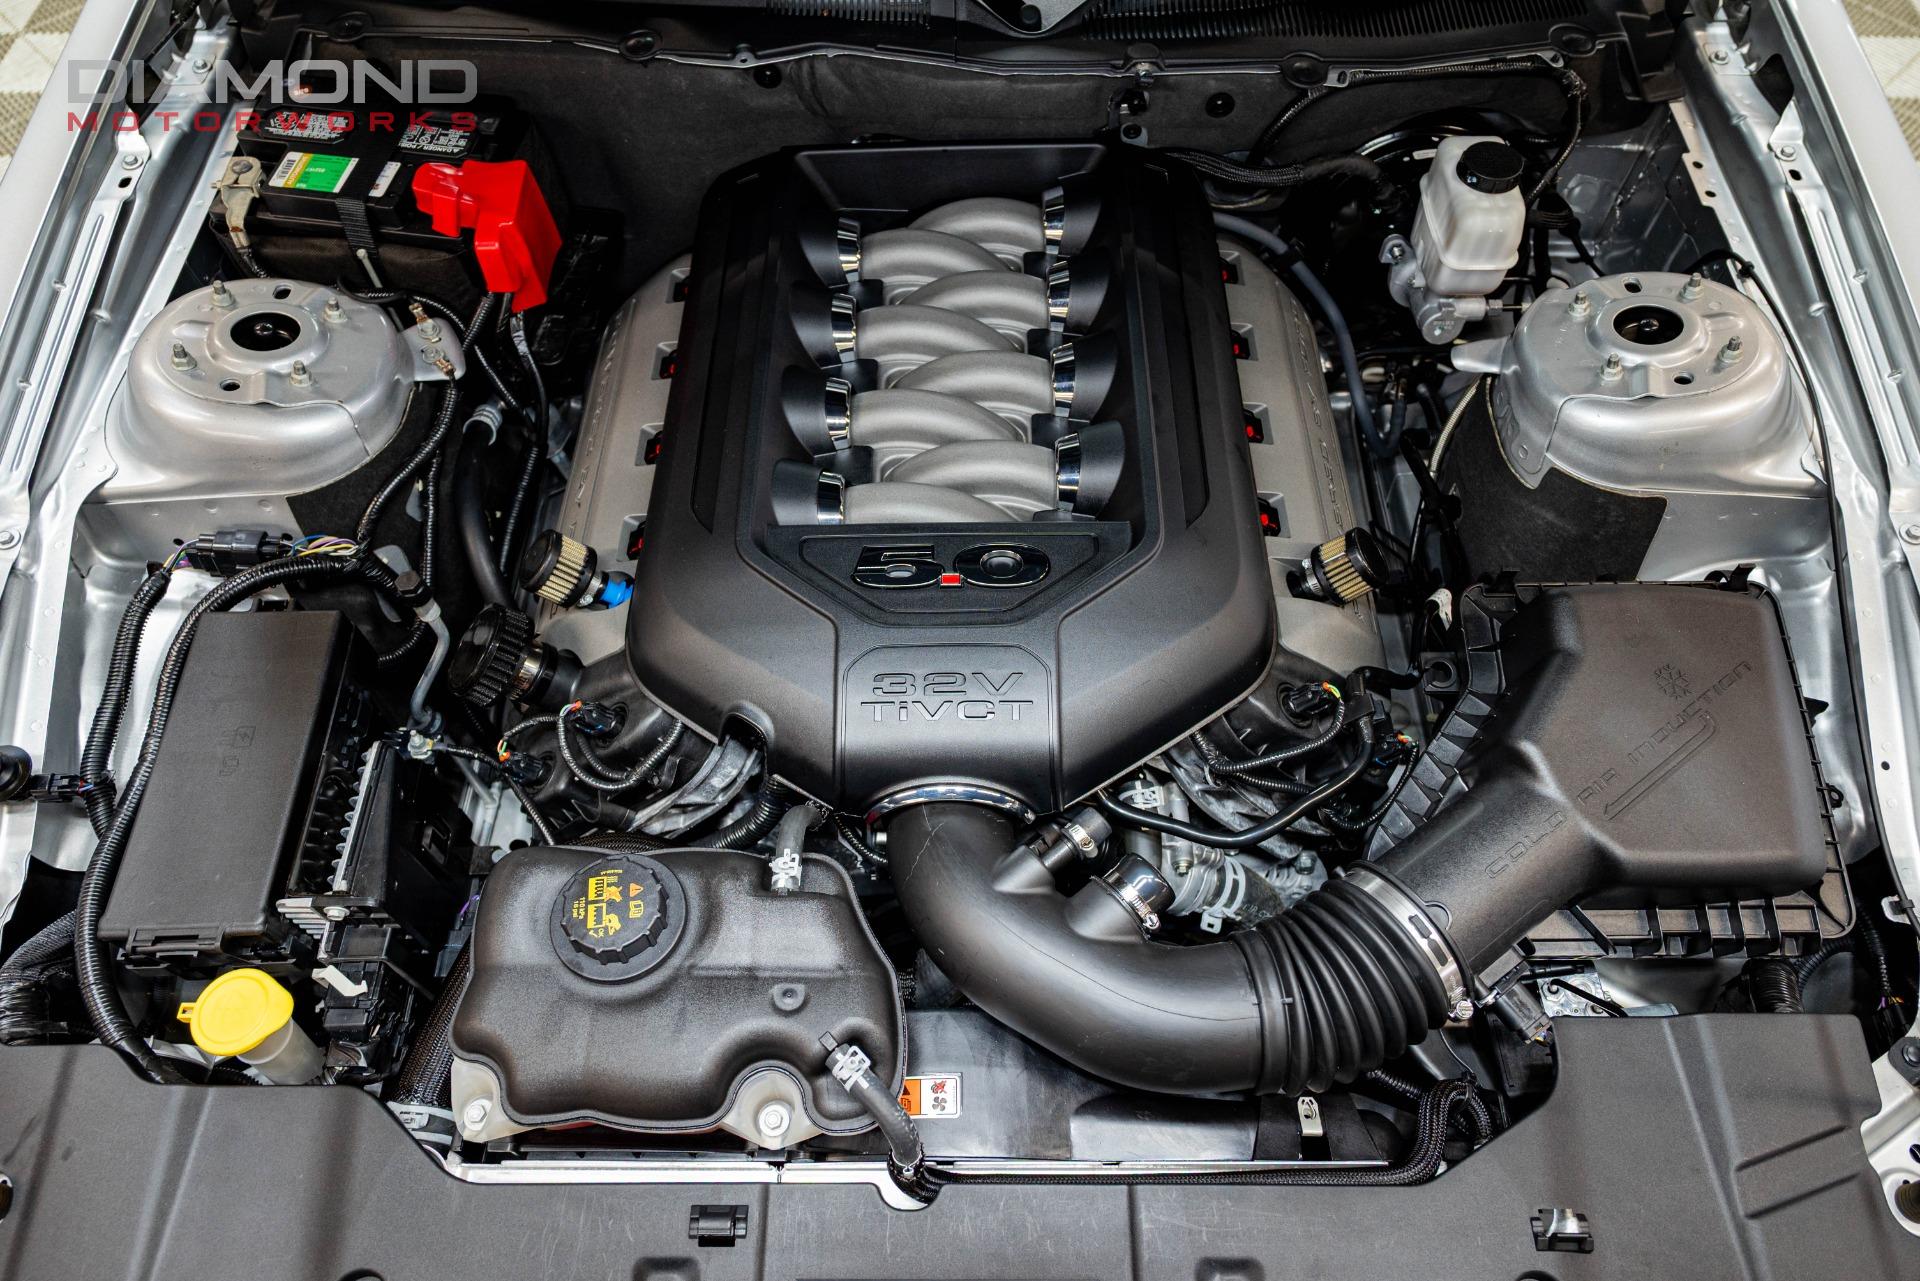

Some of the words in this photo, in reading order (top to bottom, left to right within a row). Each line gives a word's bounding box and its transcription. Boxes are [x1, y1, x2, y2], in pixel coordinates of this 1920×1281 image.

[851, 542, 1050, 589] 5.0
[872, 672, 1024, 696] 32V
[1485, 811, 1567, 879] COLD
